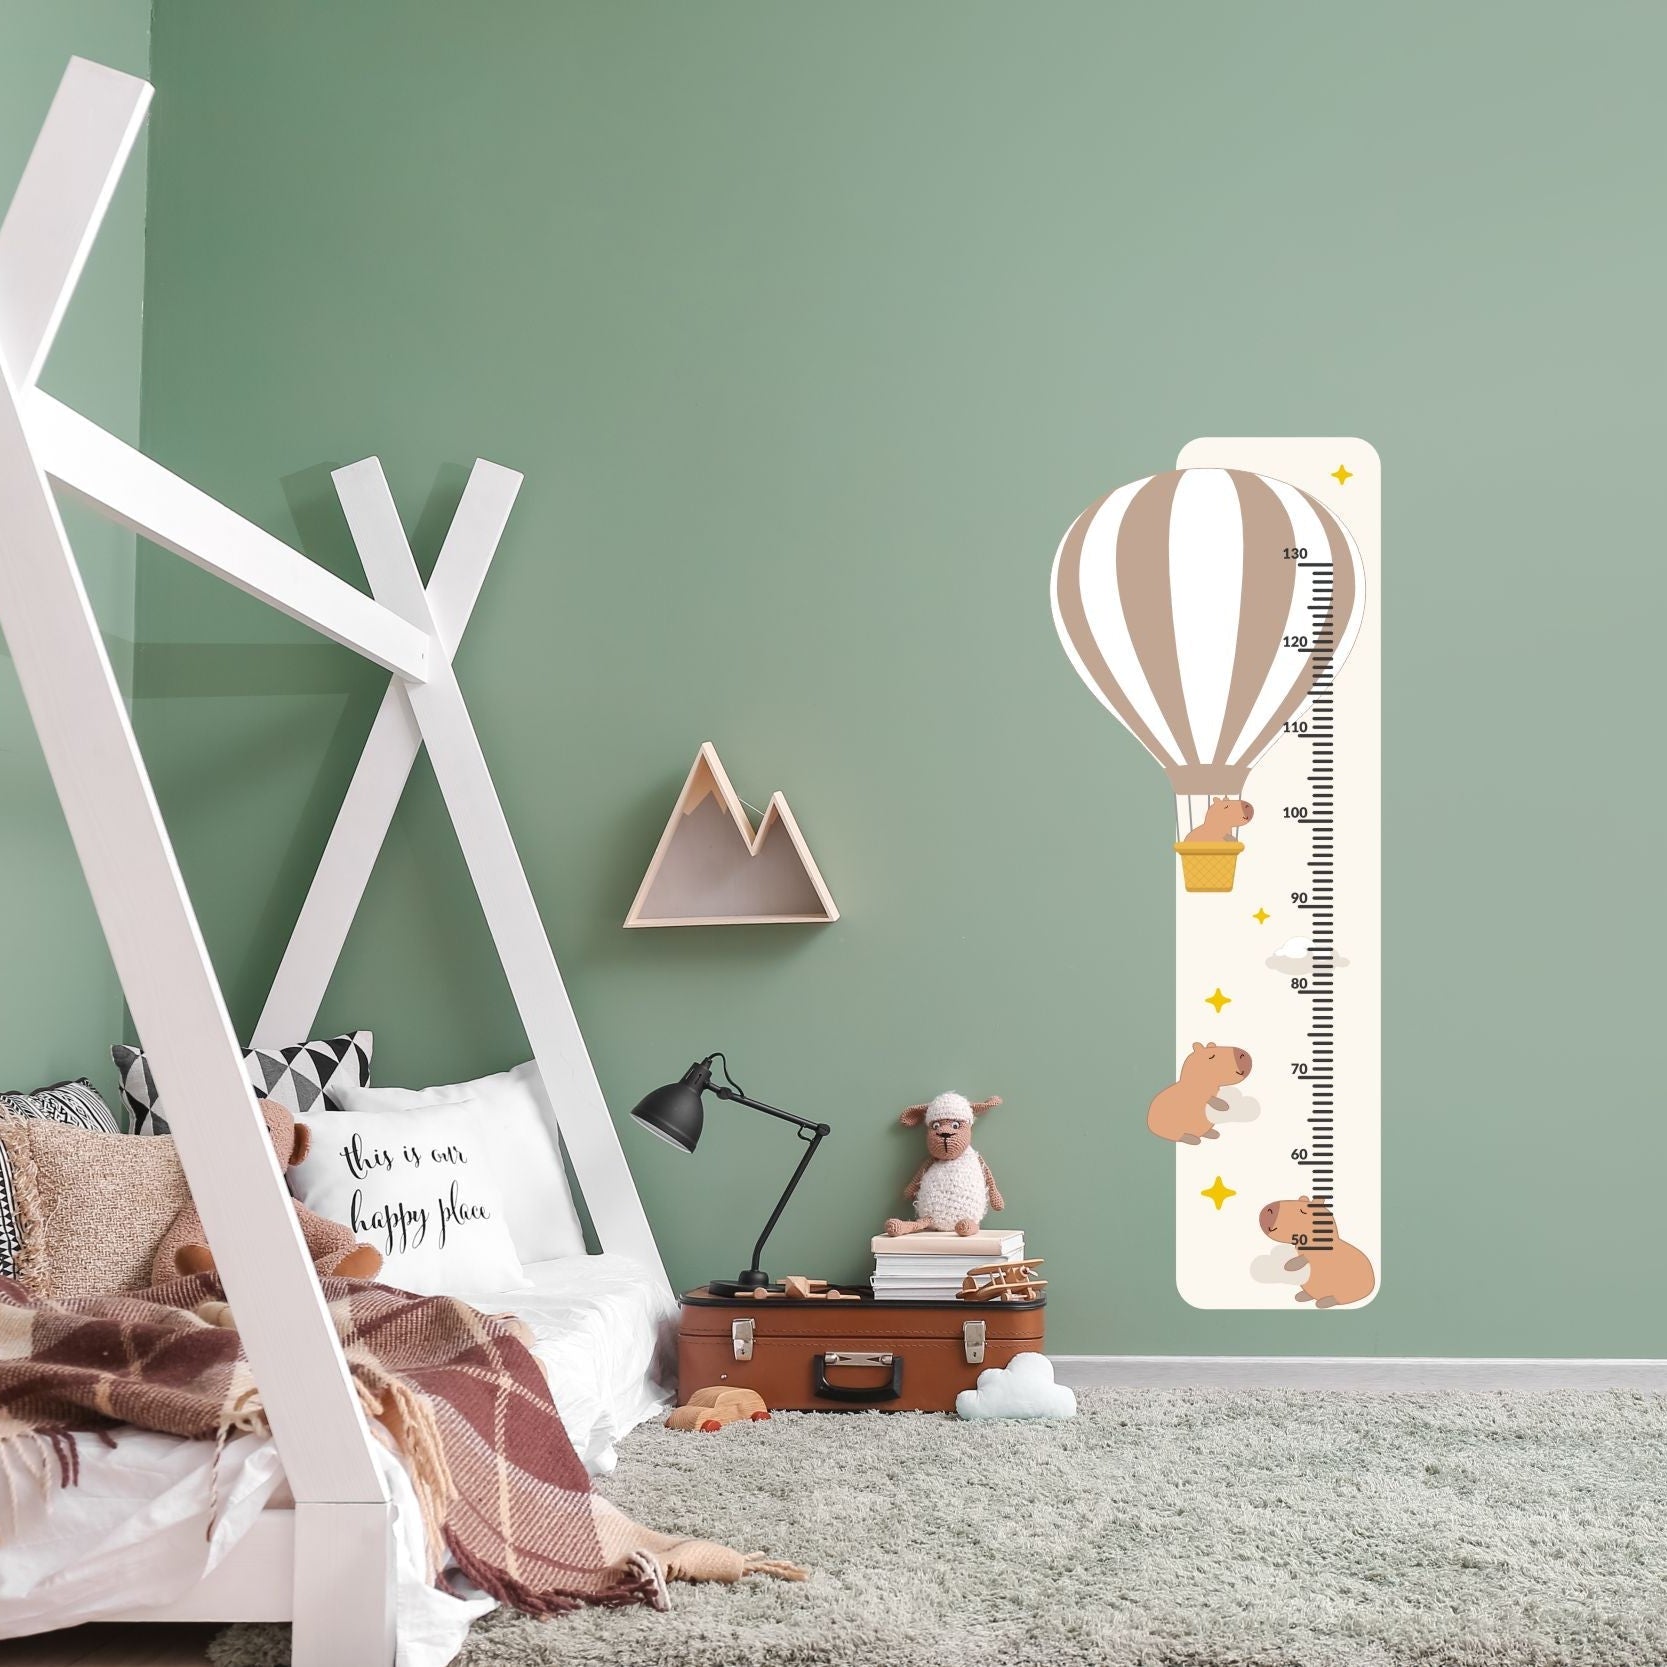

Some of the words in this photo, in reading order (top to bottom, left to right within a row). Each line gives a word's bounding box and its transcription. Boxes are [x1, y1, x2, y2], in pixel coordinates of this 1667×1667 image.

[1283, 547, 1308, 560] 130
[1283, 635, 1308, 648] 120
[1283, 721, 1308, 733] 110
[1283, 806, 1308, 819] 100
[1290, 892, 1308, 904] 90
[1290, 977, 1308, 990] 80
[1290, 1063, 1308, 1075] 70
[340, 1132, 394, 1180] this
[403, 1145, 421, 1168] is
[431, 1146, 468, 1164] our
[1290, 1148, 1308, 1161] 60
[350, 1188, 430, 1256] happy
[438, 1179, 491, 1250] place
[1290, 1234, 1308, 1246] 50
